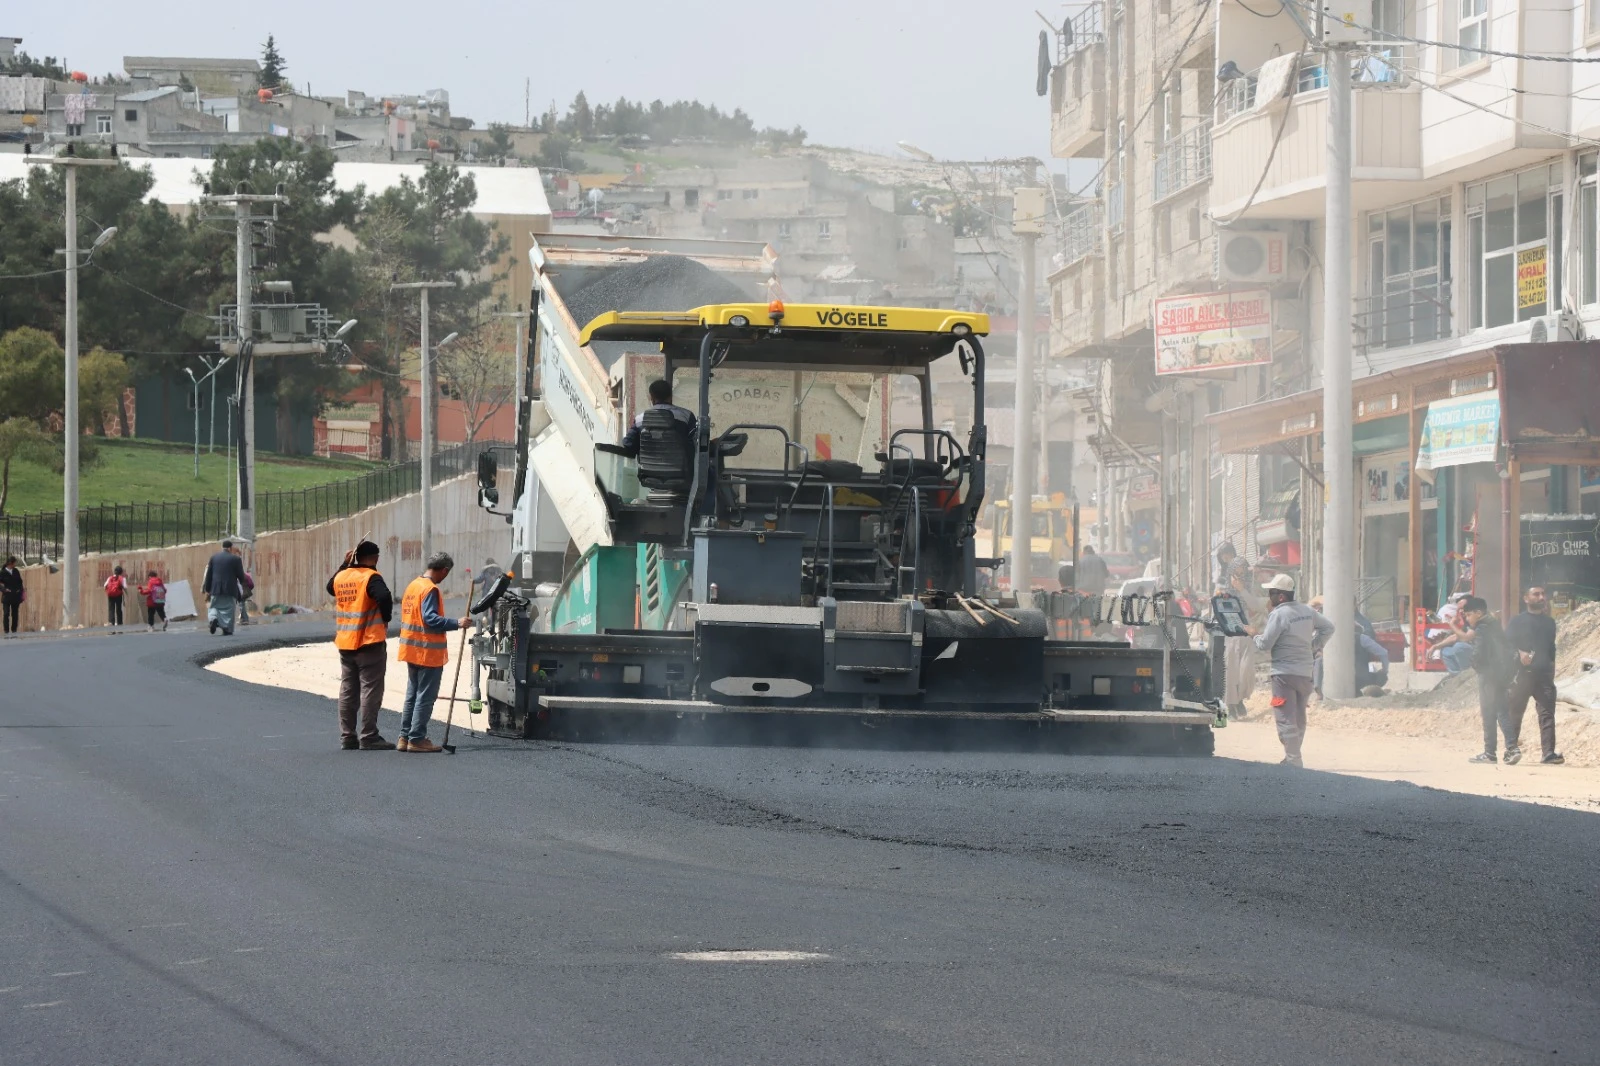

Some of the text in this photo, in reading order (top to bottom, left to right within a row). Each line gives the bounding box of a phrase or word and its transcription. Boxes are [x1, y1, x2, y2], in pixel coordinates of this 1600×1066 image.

[816, 308, 888, 327] VÖGELE
[1463, 404, 1497, 422] MARKET
[1562, 540, 1590, 550] CHIPS
